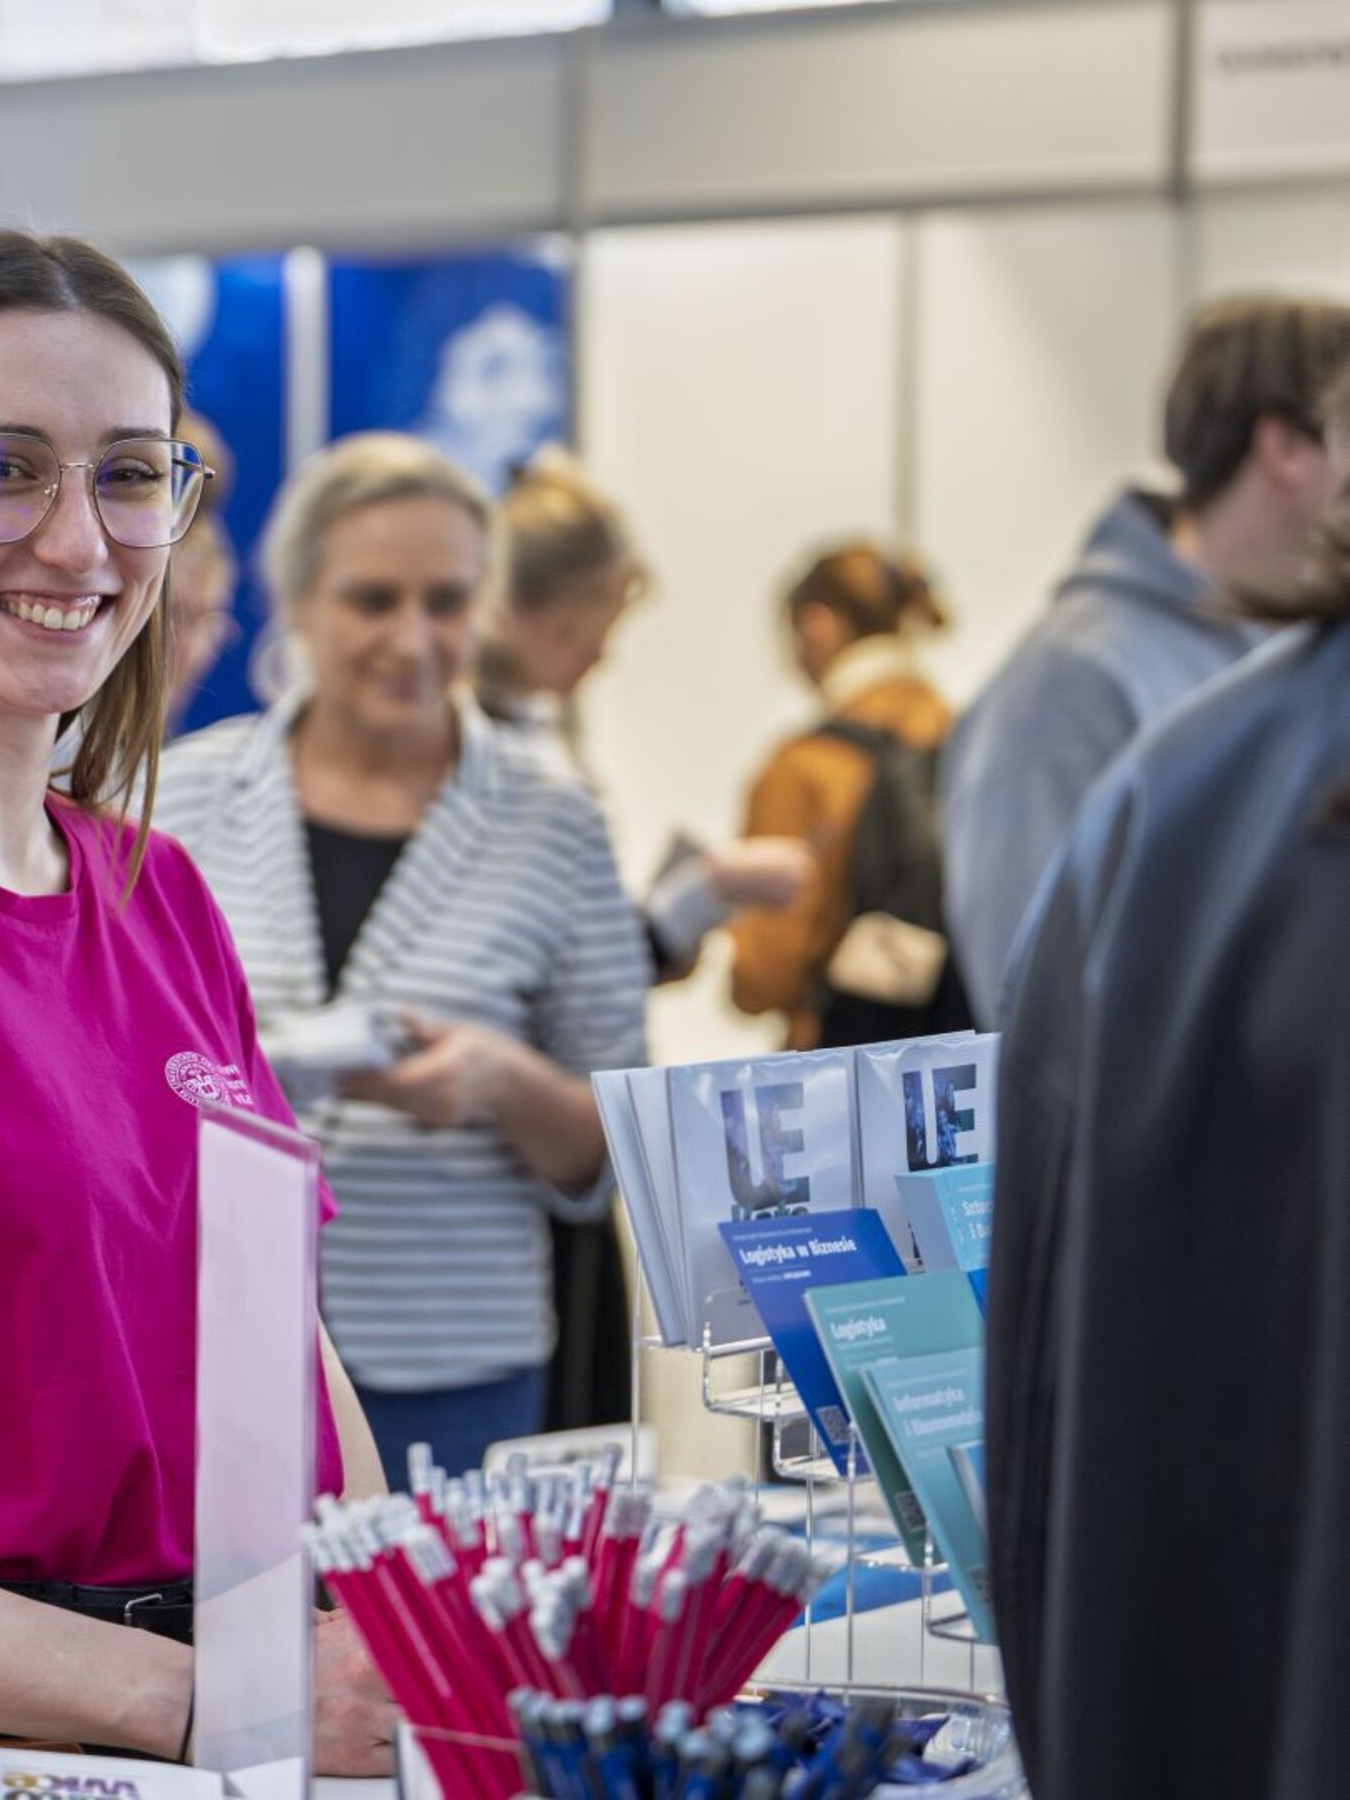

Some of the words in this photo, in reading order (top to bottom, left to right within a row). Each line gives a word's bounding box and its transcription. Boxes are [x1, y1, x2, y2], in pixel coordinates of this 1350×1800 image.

[720, 1081, 810, 1211] UE
[902, 1063, 978, 1172] UE
[738, 1245, 796, 1266] Logistyka
[796, 1245, 809, 1257] w
[808, 1235, 857, 1256] Biznesie
[830, 1316, 886, 1341] Logistyka
